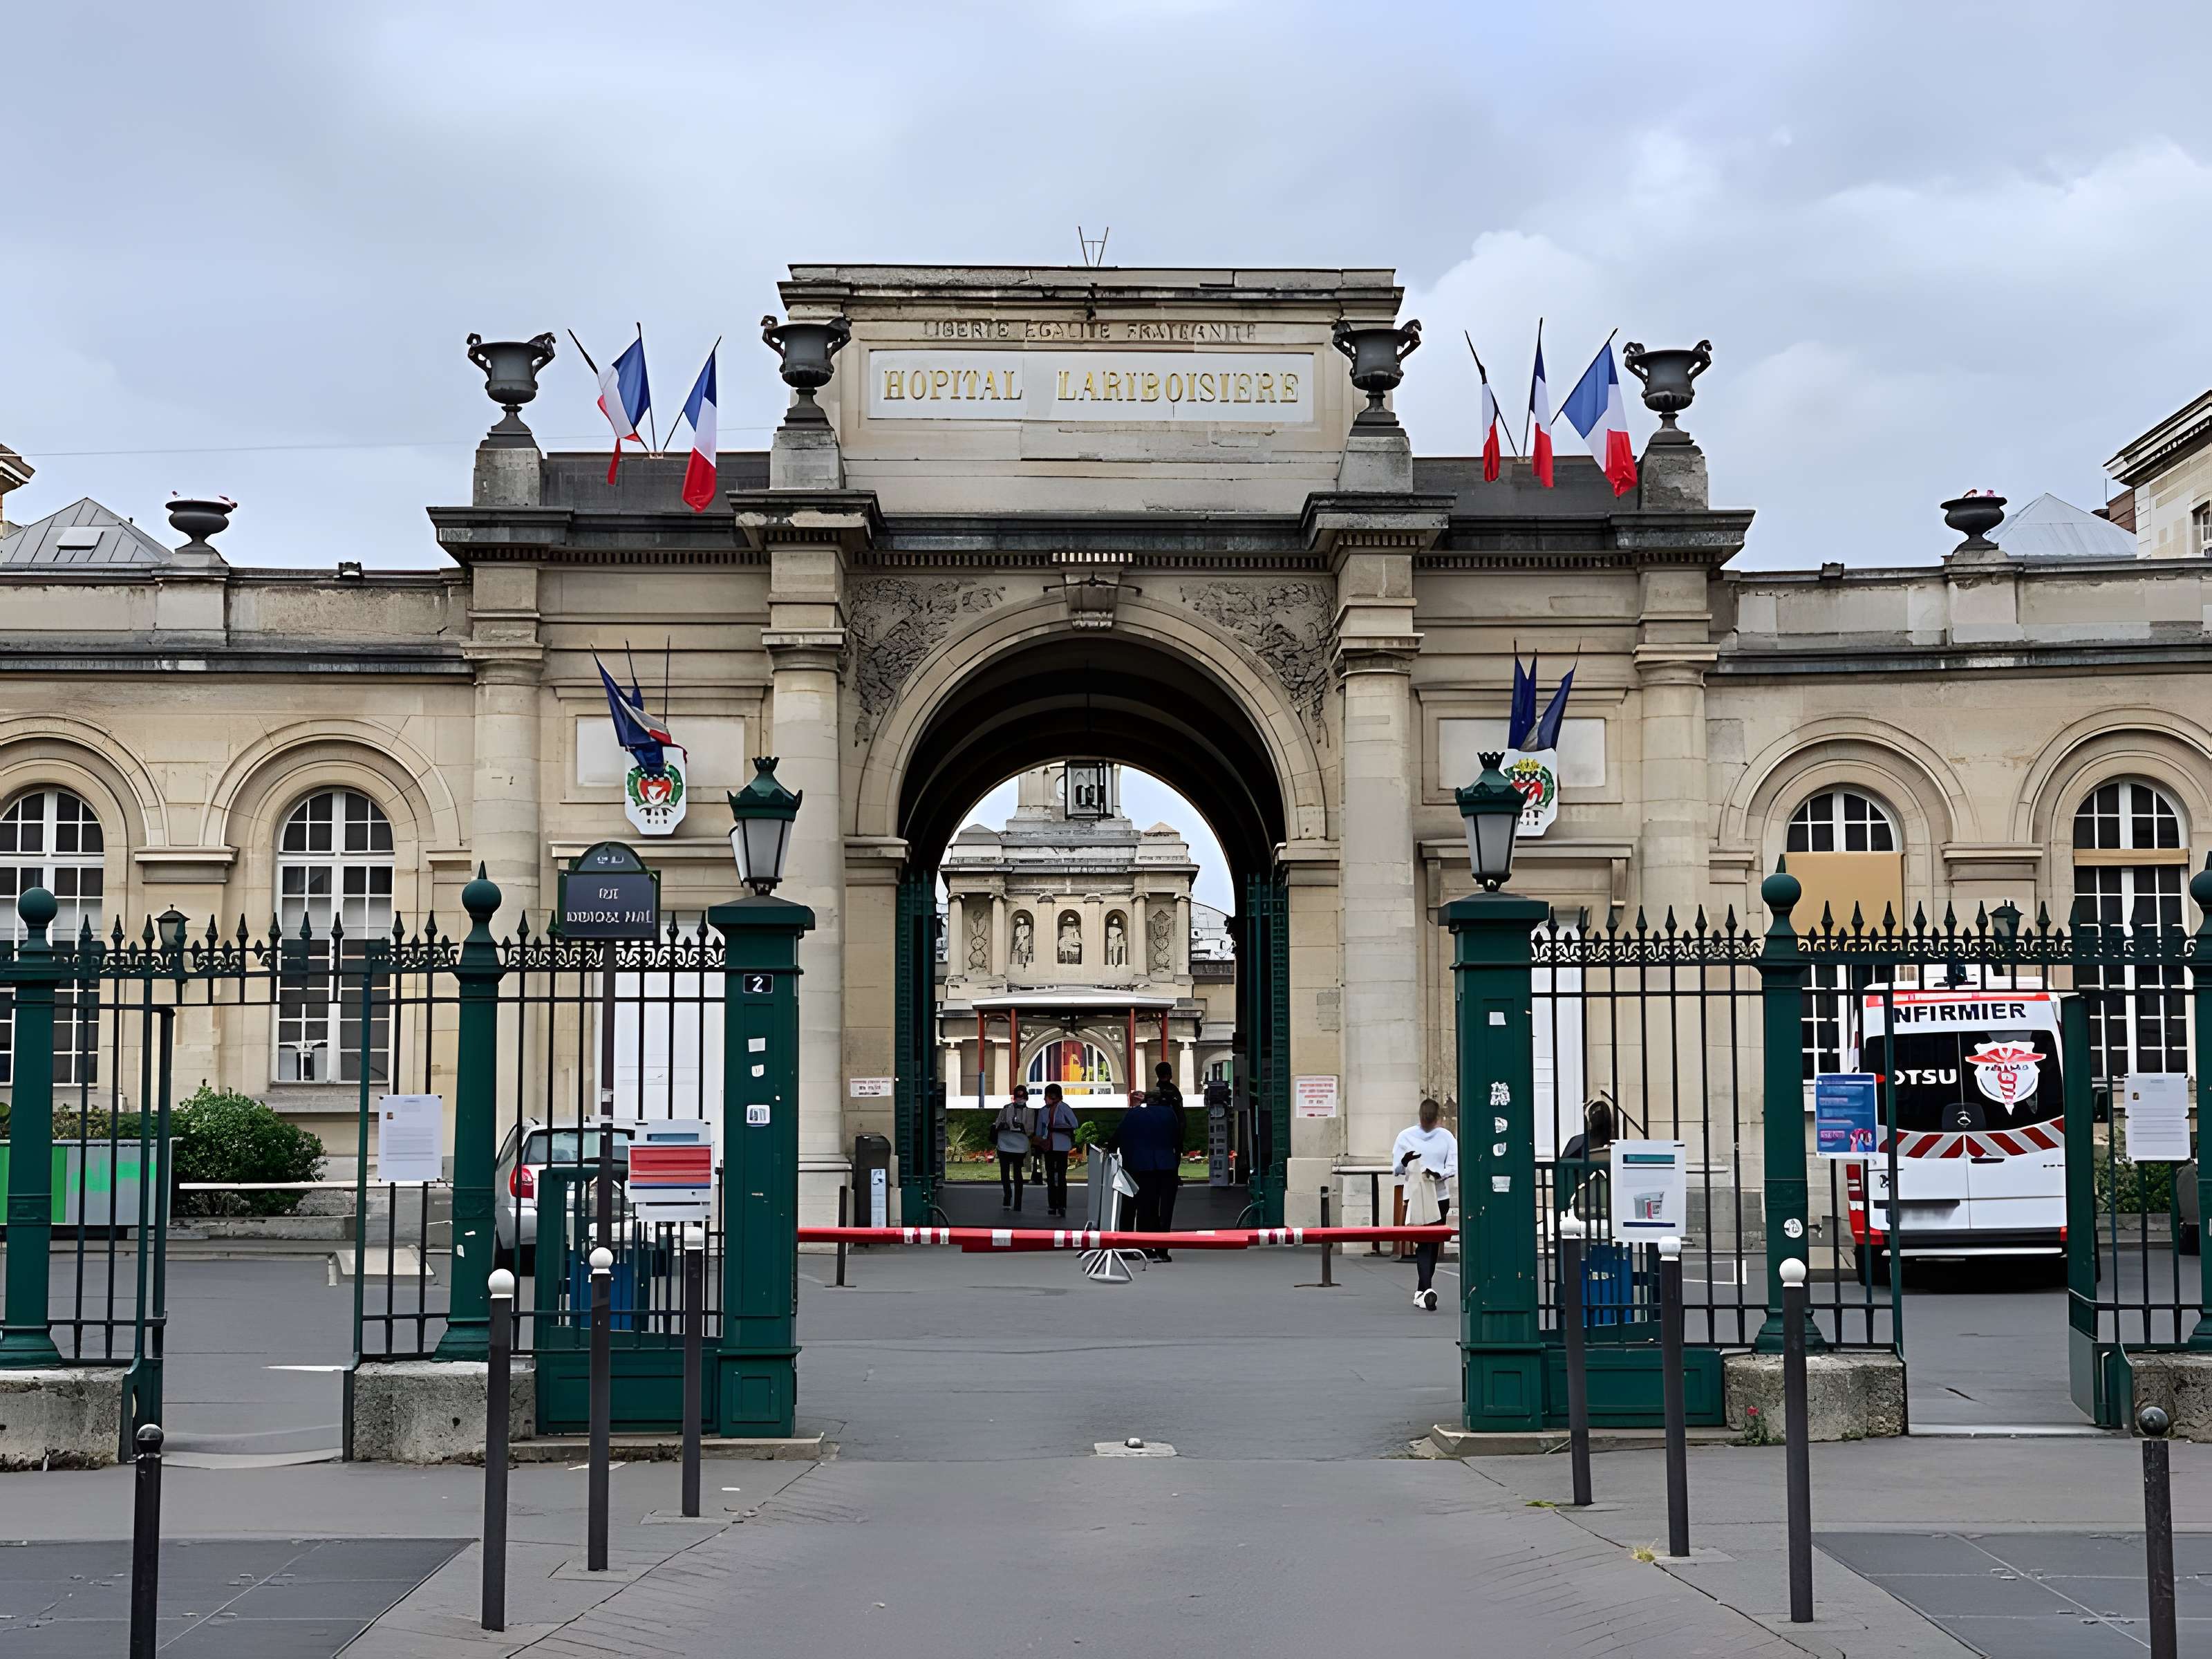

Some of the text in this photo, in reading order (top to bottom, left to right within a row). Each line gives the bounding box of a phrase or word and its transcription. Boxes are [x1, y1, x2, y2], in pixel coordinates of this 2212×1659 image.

[884, 370, 1299, 403] HOPITAL LARIBOISIERE
[752, 976, 763, 993] 2
[1893, 1003, 2027, 1024] NFIRMIER
